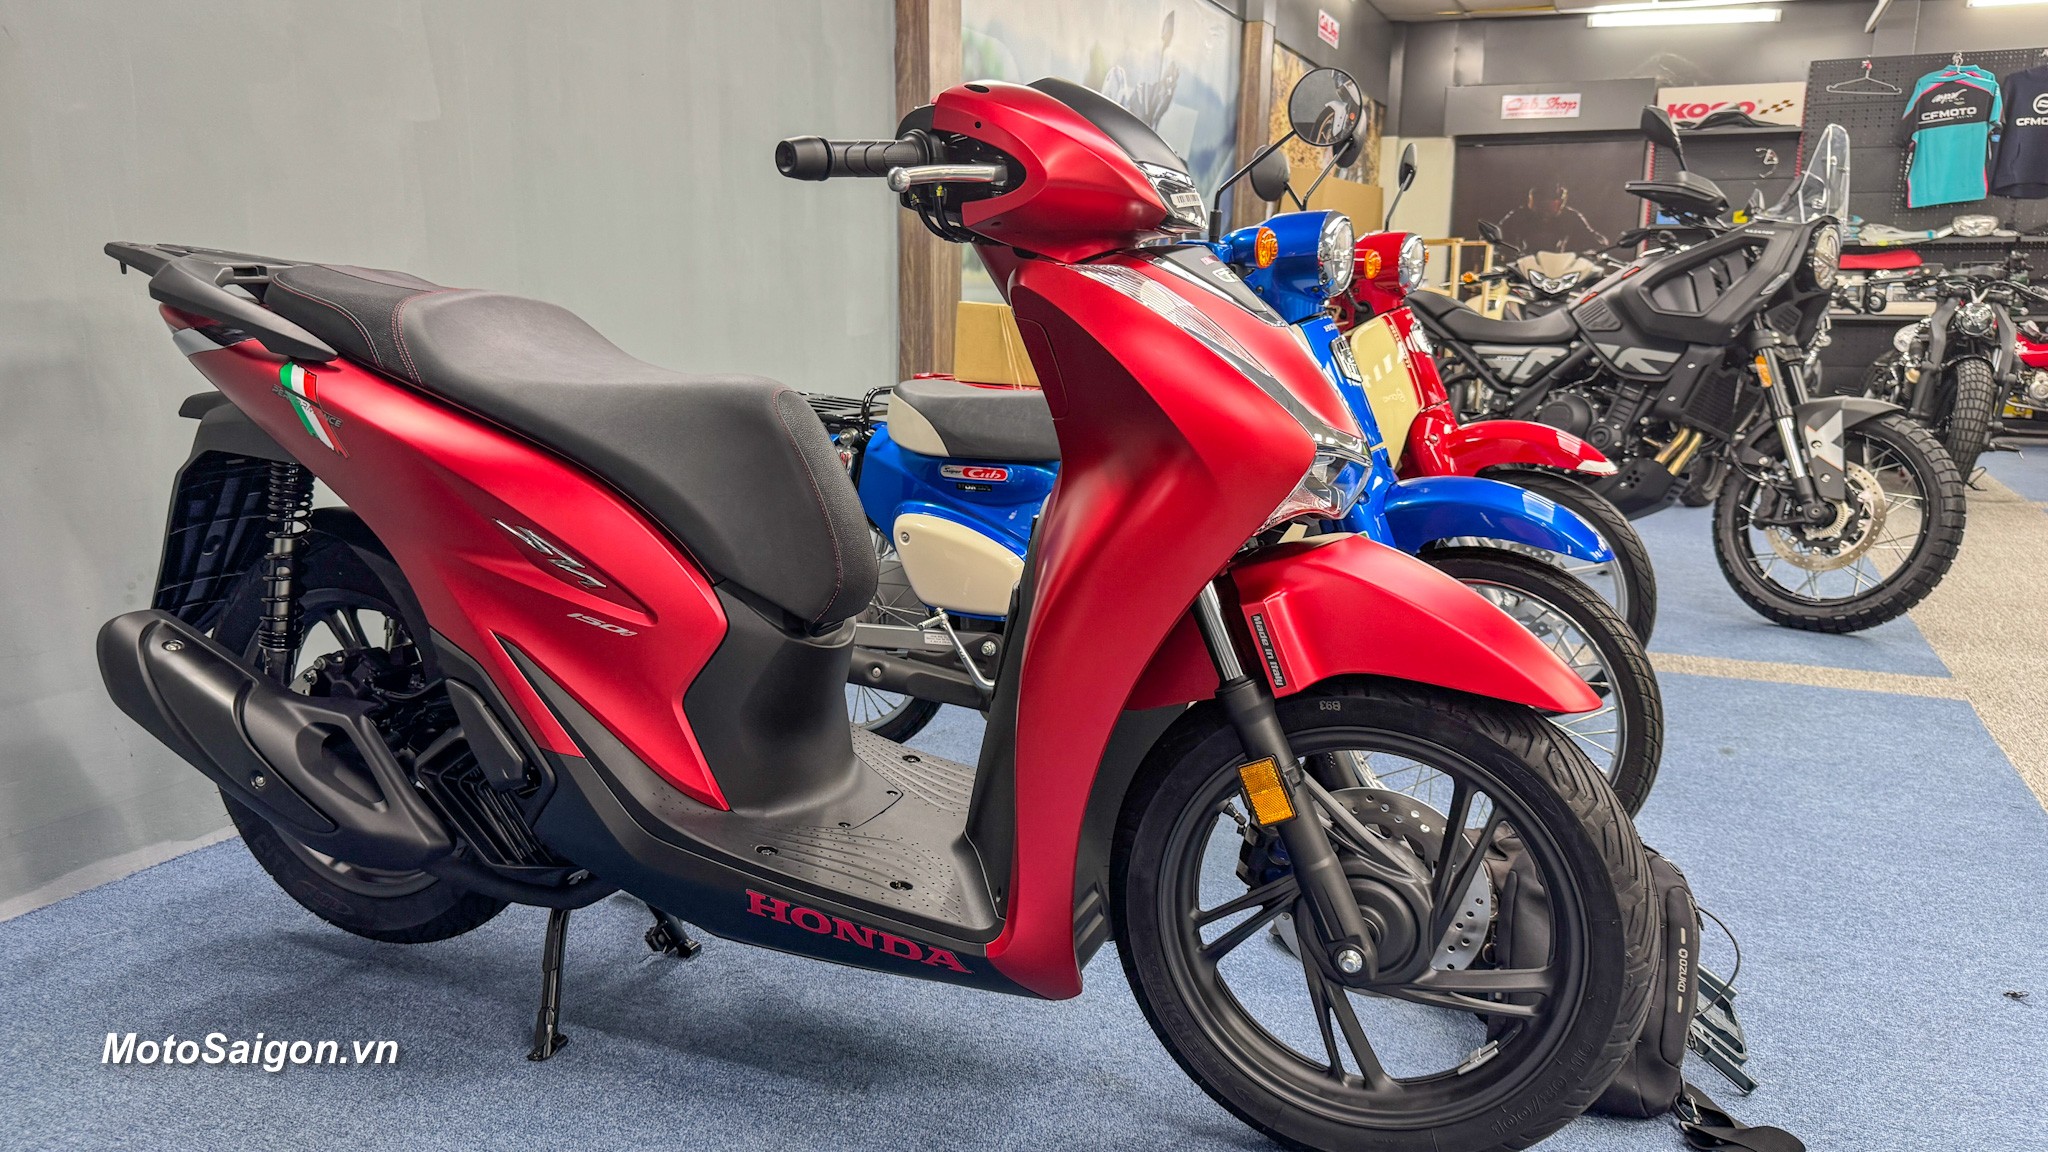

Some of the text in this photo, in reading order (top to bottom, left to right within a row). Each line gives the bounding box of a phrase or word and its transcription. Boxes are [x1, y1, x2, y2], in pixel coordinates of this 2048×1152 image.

[1541, 96, 1577, 114] Shop
[1921, 106, 1977, 121] CFMOTO
[272, 384, 342, 427] PERORMNCE
[943, 467, 1001, 479] Super Cub
[1252, 615, 1269, 646] Made
[1269, 661, 1284, 686] Italy
[1319, 700, 1341, 711] B93
[745, 888, 974, 974] HONDA
